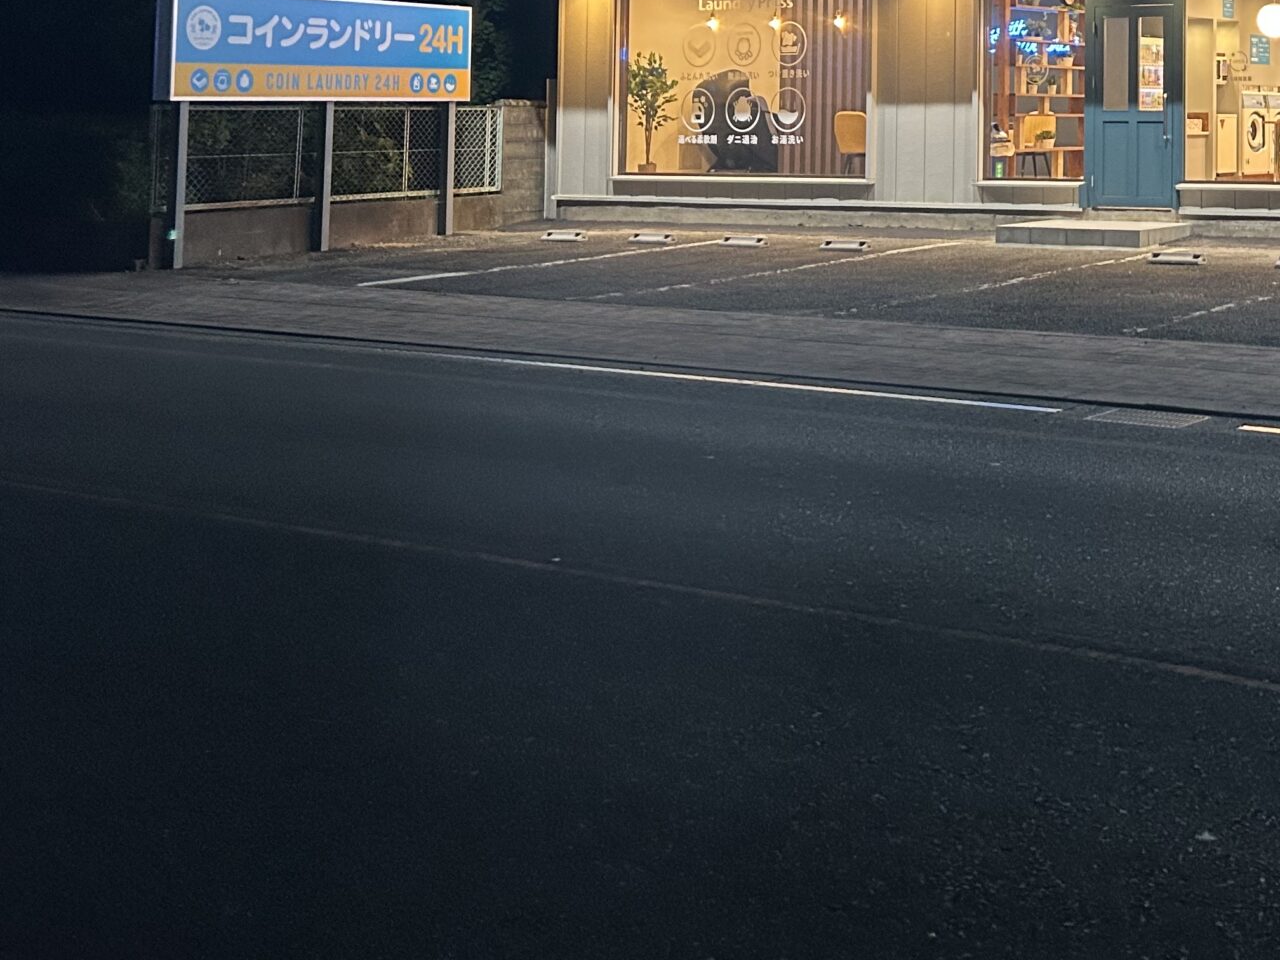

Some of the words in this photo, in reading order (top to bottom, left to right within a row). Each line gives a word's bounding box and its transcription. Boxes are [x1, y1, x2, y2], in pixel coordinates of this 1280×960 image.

[228, 14, 415, 53] コインランドリー
[419, 23, 463, 54] 24H
[266, 72, 300, 91] COIN
[307, 73, 369, 91] LAUNDRY
[375, 74, 400, 91] 24H
